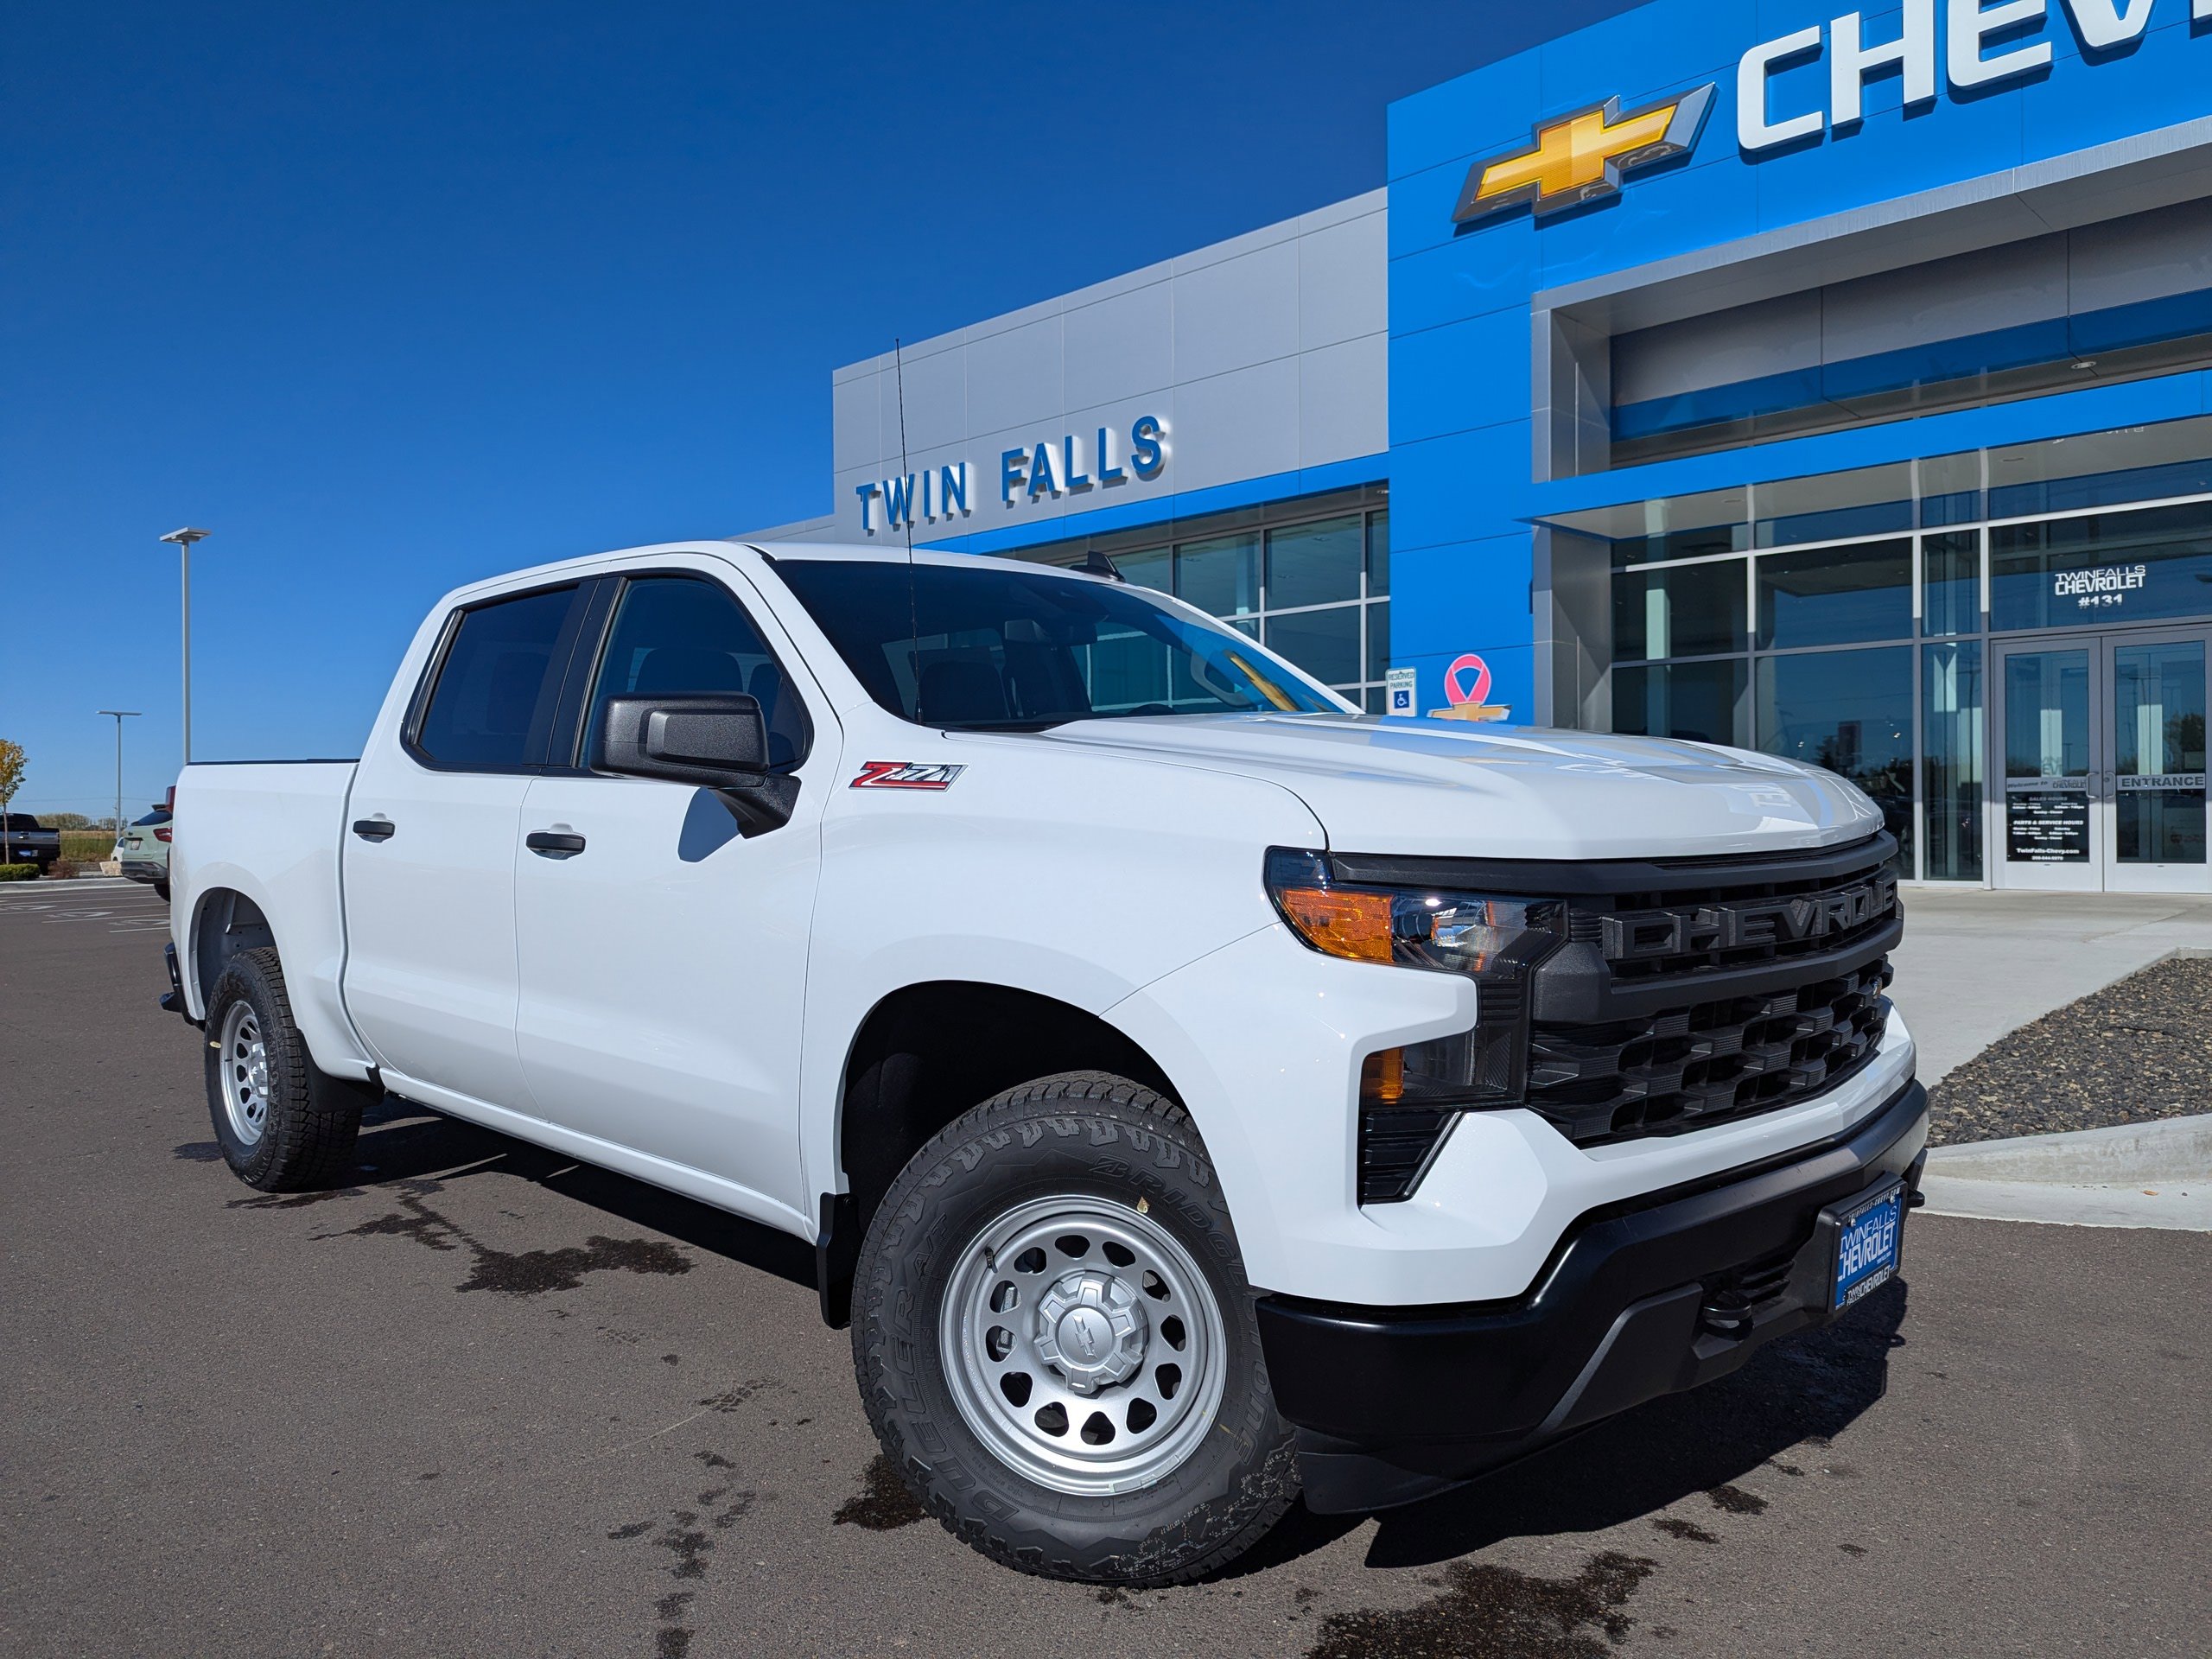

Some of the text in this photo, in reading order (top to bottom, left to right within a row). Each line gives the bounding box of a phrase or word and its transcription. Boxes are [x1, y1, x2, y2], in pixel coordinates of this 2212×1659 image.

[855, 415, 1166, 533] TWIN FALLS
[2055, 565, 2146, 582] TWINFALLS
[2055, 573, 2146, 596] CHEVROLET
[2078, 594, 2123, 607] #131
[848, 760, 969, 793] Z71
[2121, 776, 2205, 788] ENTRANCE
[893, 1288, 1021, 1523] DUELER
